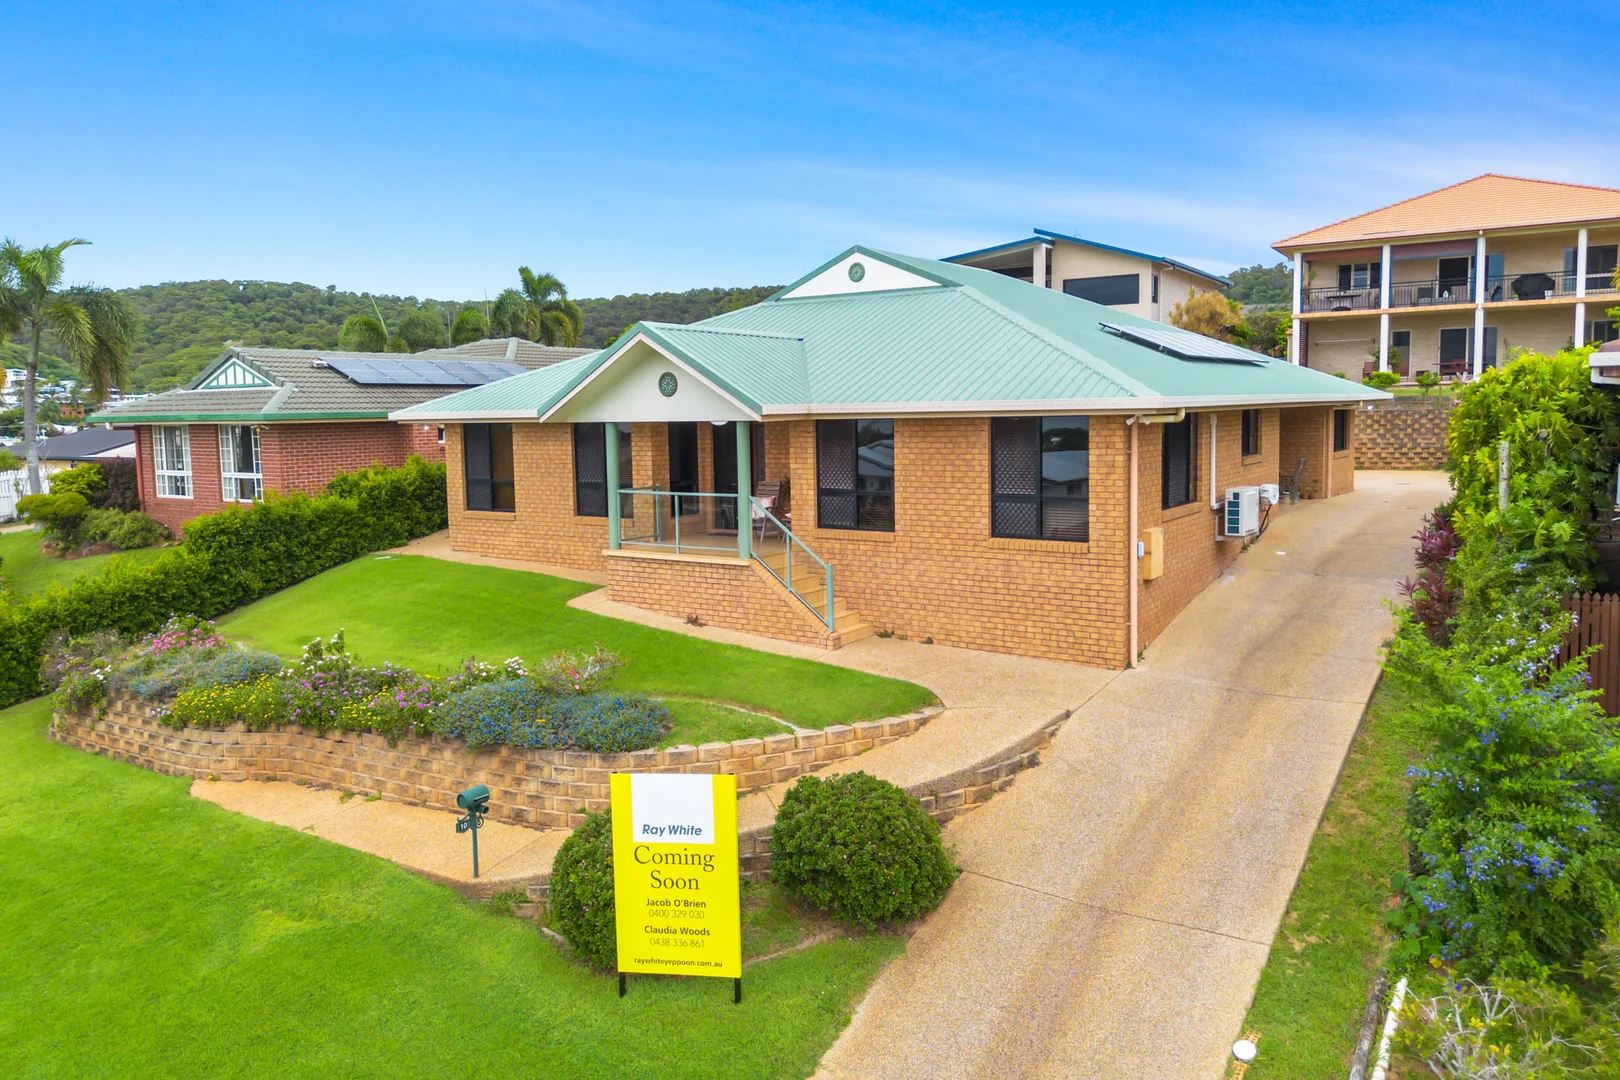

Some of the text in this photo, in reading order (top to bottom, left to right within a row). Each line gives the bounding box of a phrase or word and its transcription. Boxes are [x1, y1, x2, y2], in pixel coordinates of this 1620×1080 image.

[642, 824, 702, 837] Ray White
[634, 845, 715, 872] Coming
[650, 870, 700, 890] Soon
[646, 898, 706, 908] Jacob O'Brien
[648, 909, 705, 919] 0400 329 030
[644, 925, 711, 936] Claudia Woods
[650, 937, 705, 948] 0438 336 861
[634, 957, 723, 967] raywhiteyeppoon.com.au
